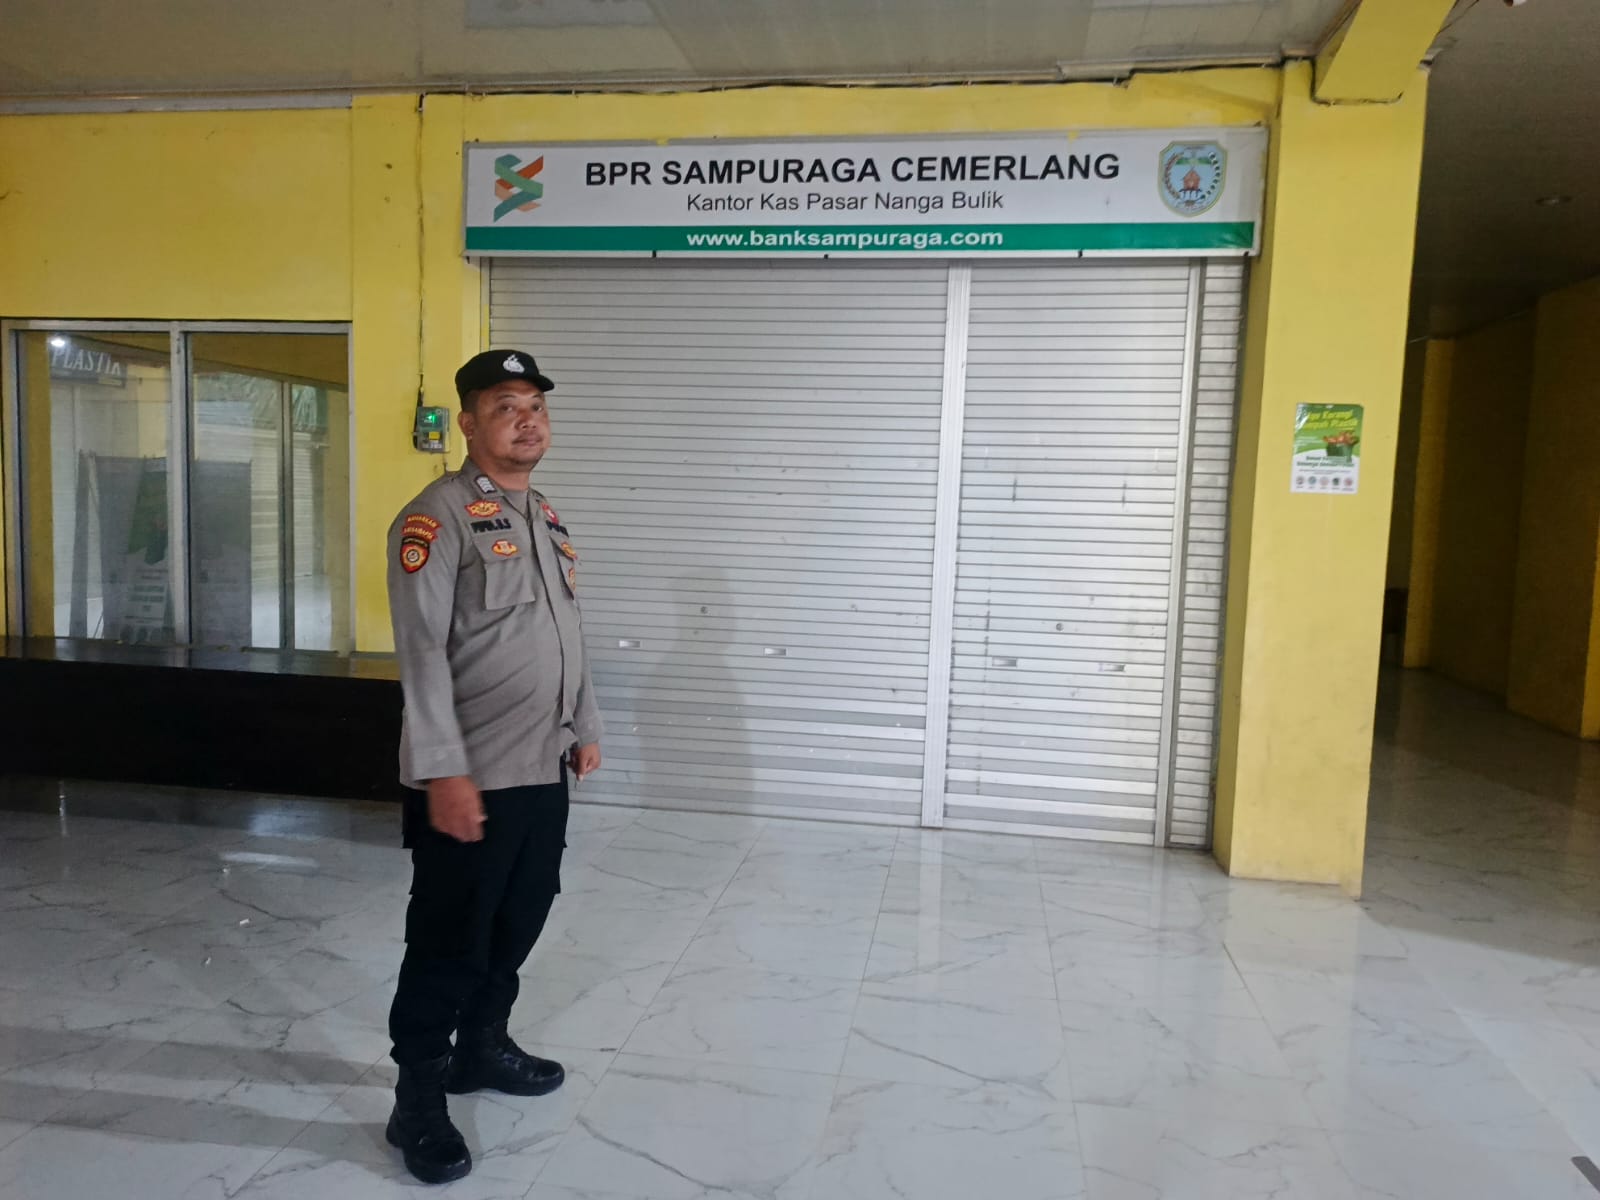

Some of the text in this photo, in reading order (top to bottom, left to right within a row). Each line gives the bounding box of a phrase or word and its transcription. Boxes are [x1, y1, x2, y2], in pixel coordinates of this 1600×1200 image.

[585, 153, 1120, 186] BPR SAMPURAGA CEMERLANG
[687, 190, 1004, 214] Kantor Kas Pasar Nanga Bulik
[686, 230, 1004, 250] www.banksampuraga.com
